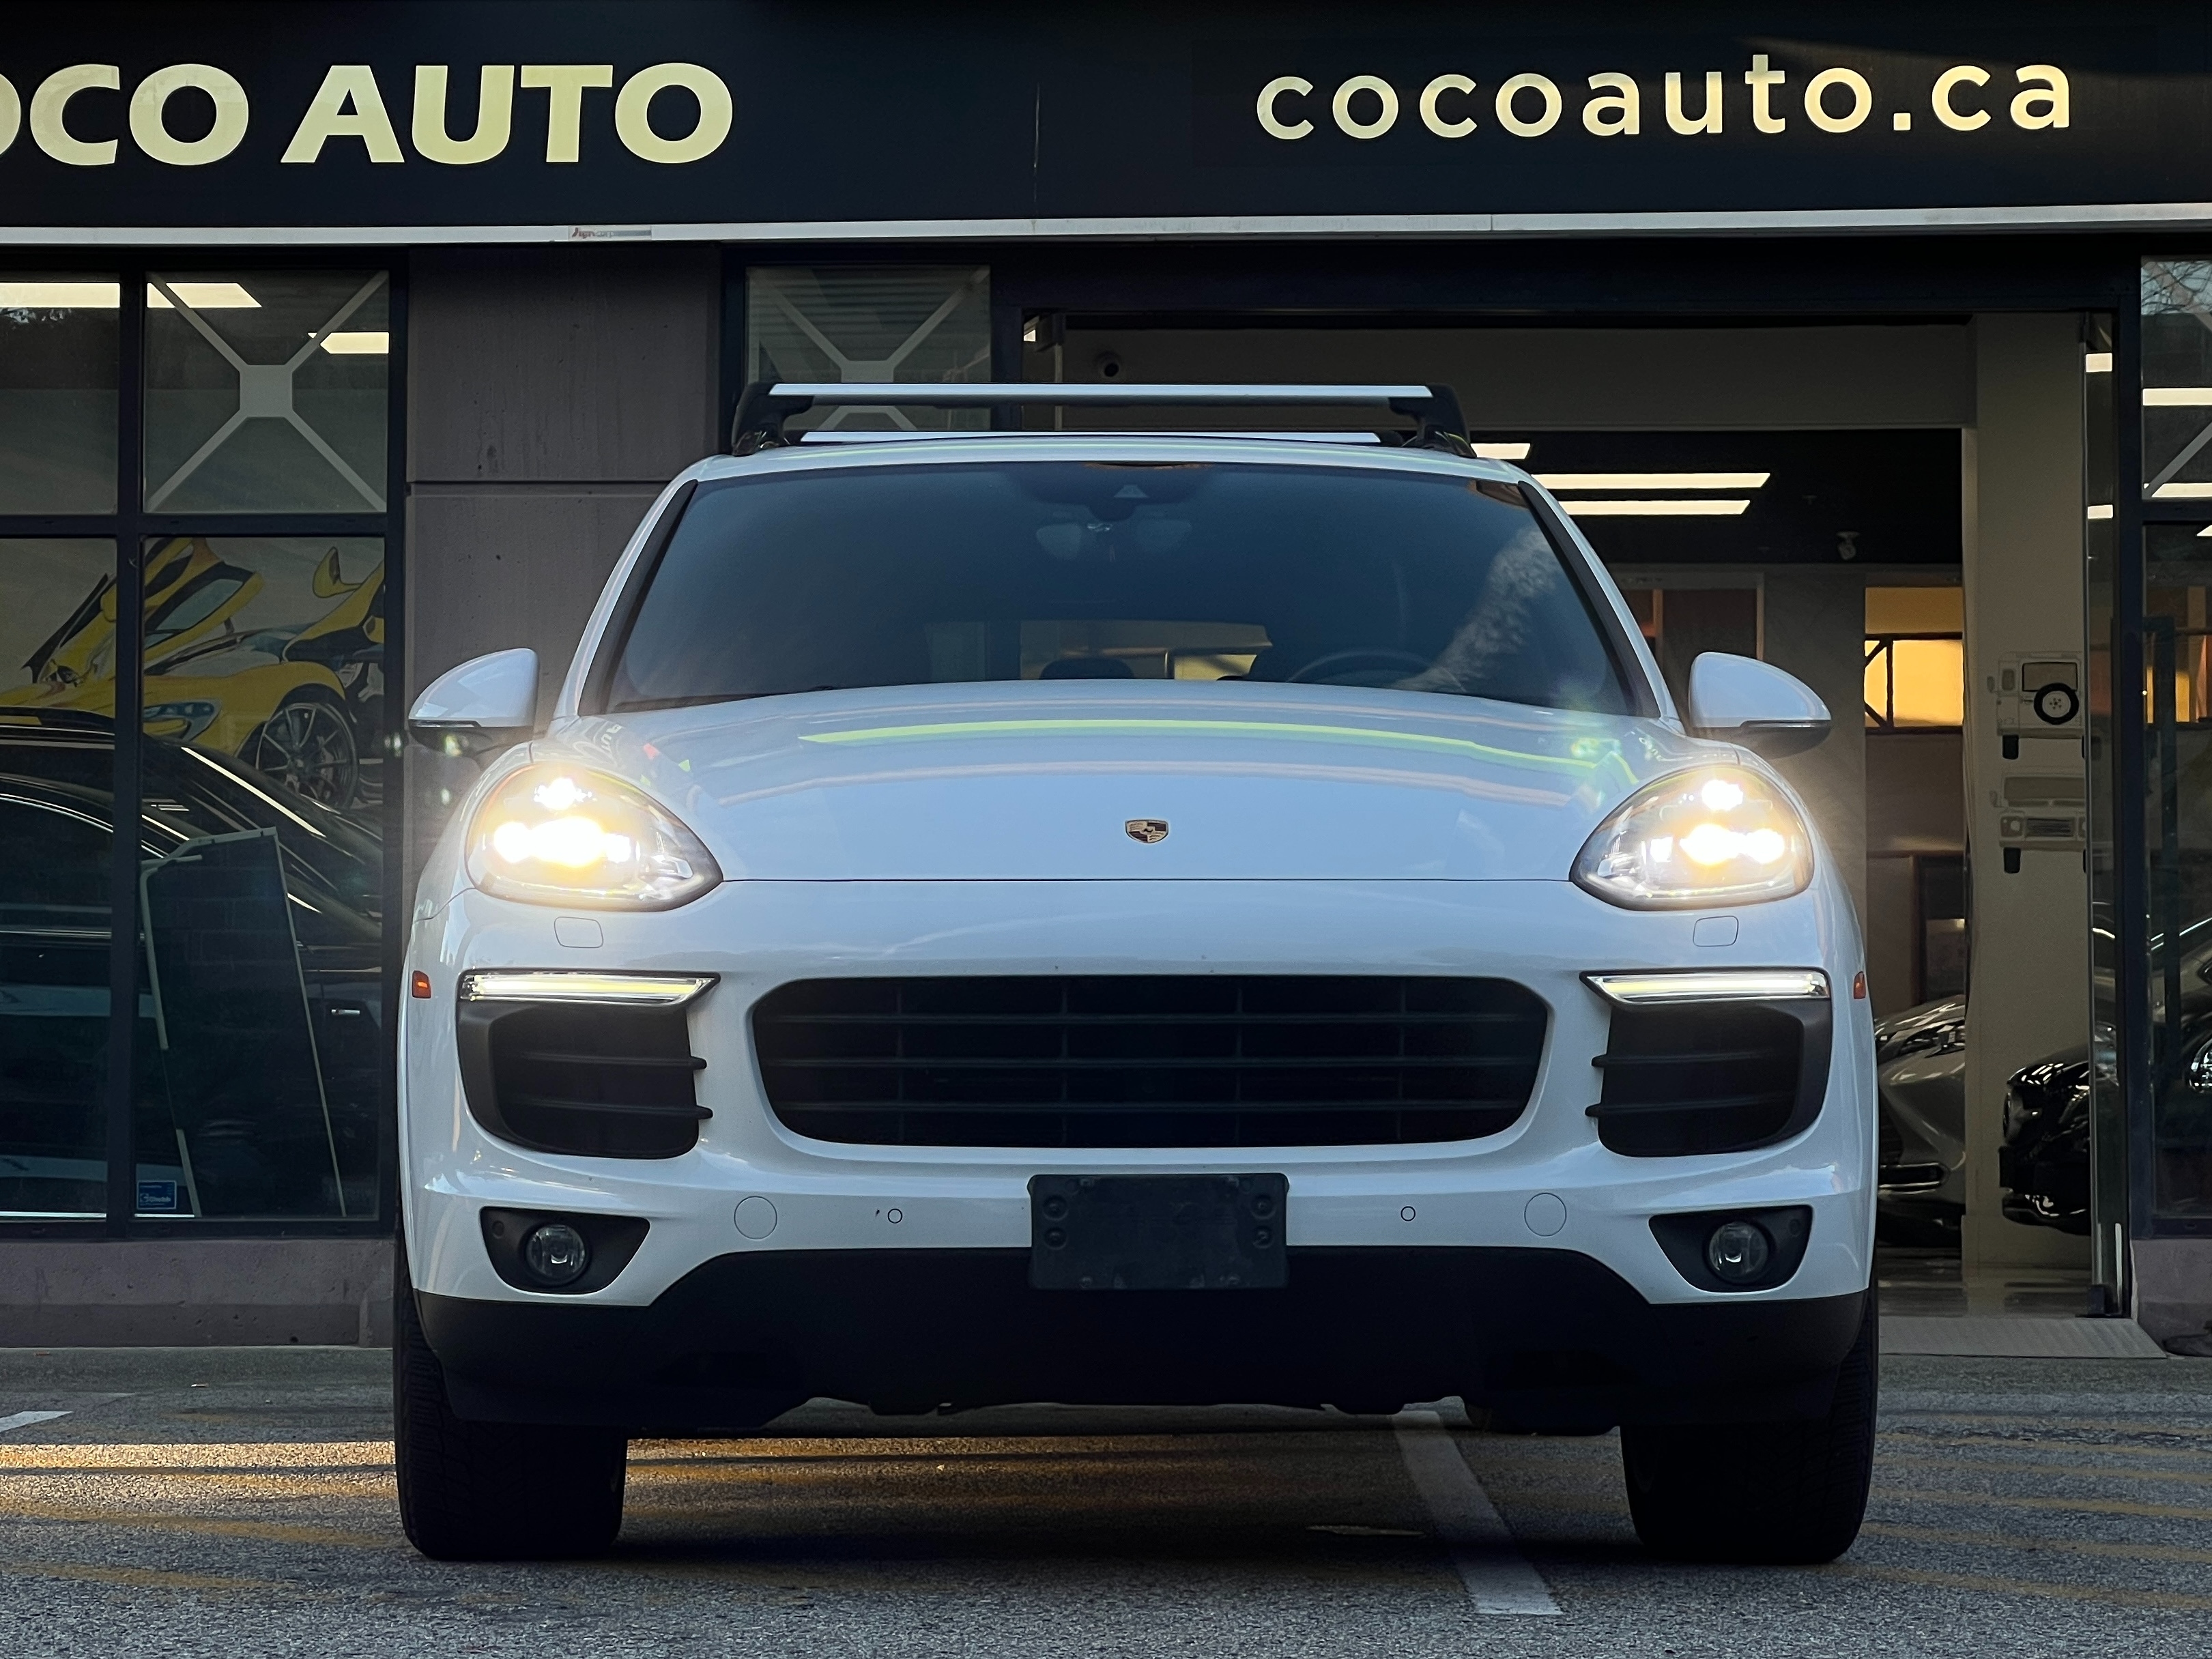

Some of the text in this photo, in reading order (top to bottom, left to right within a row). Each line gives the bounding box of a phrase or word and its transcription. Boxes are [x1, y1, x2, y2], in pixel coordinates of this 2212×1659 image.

[0, 62, 733, 166] CO AUTO
[1256, 54, 2070, 140] cocoauto.ca
